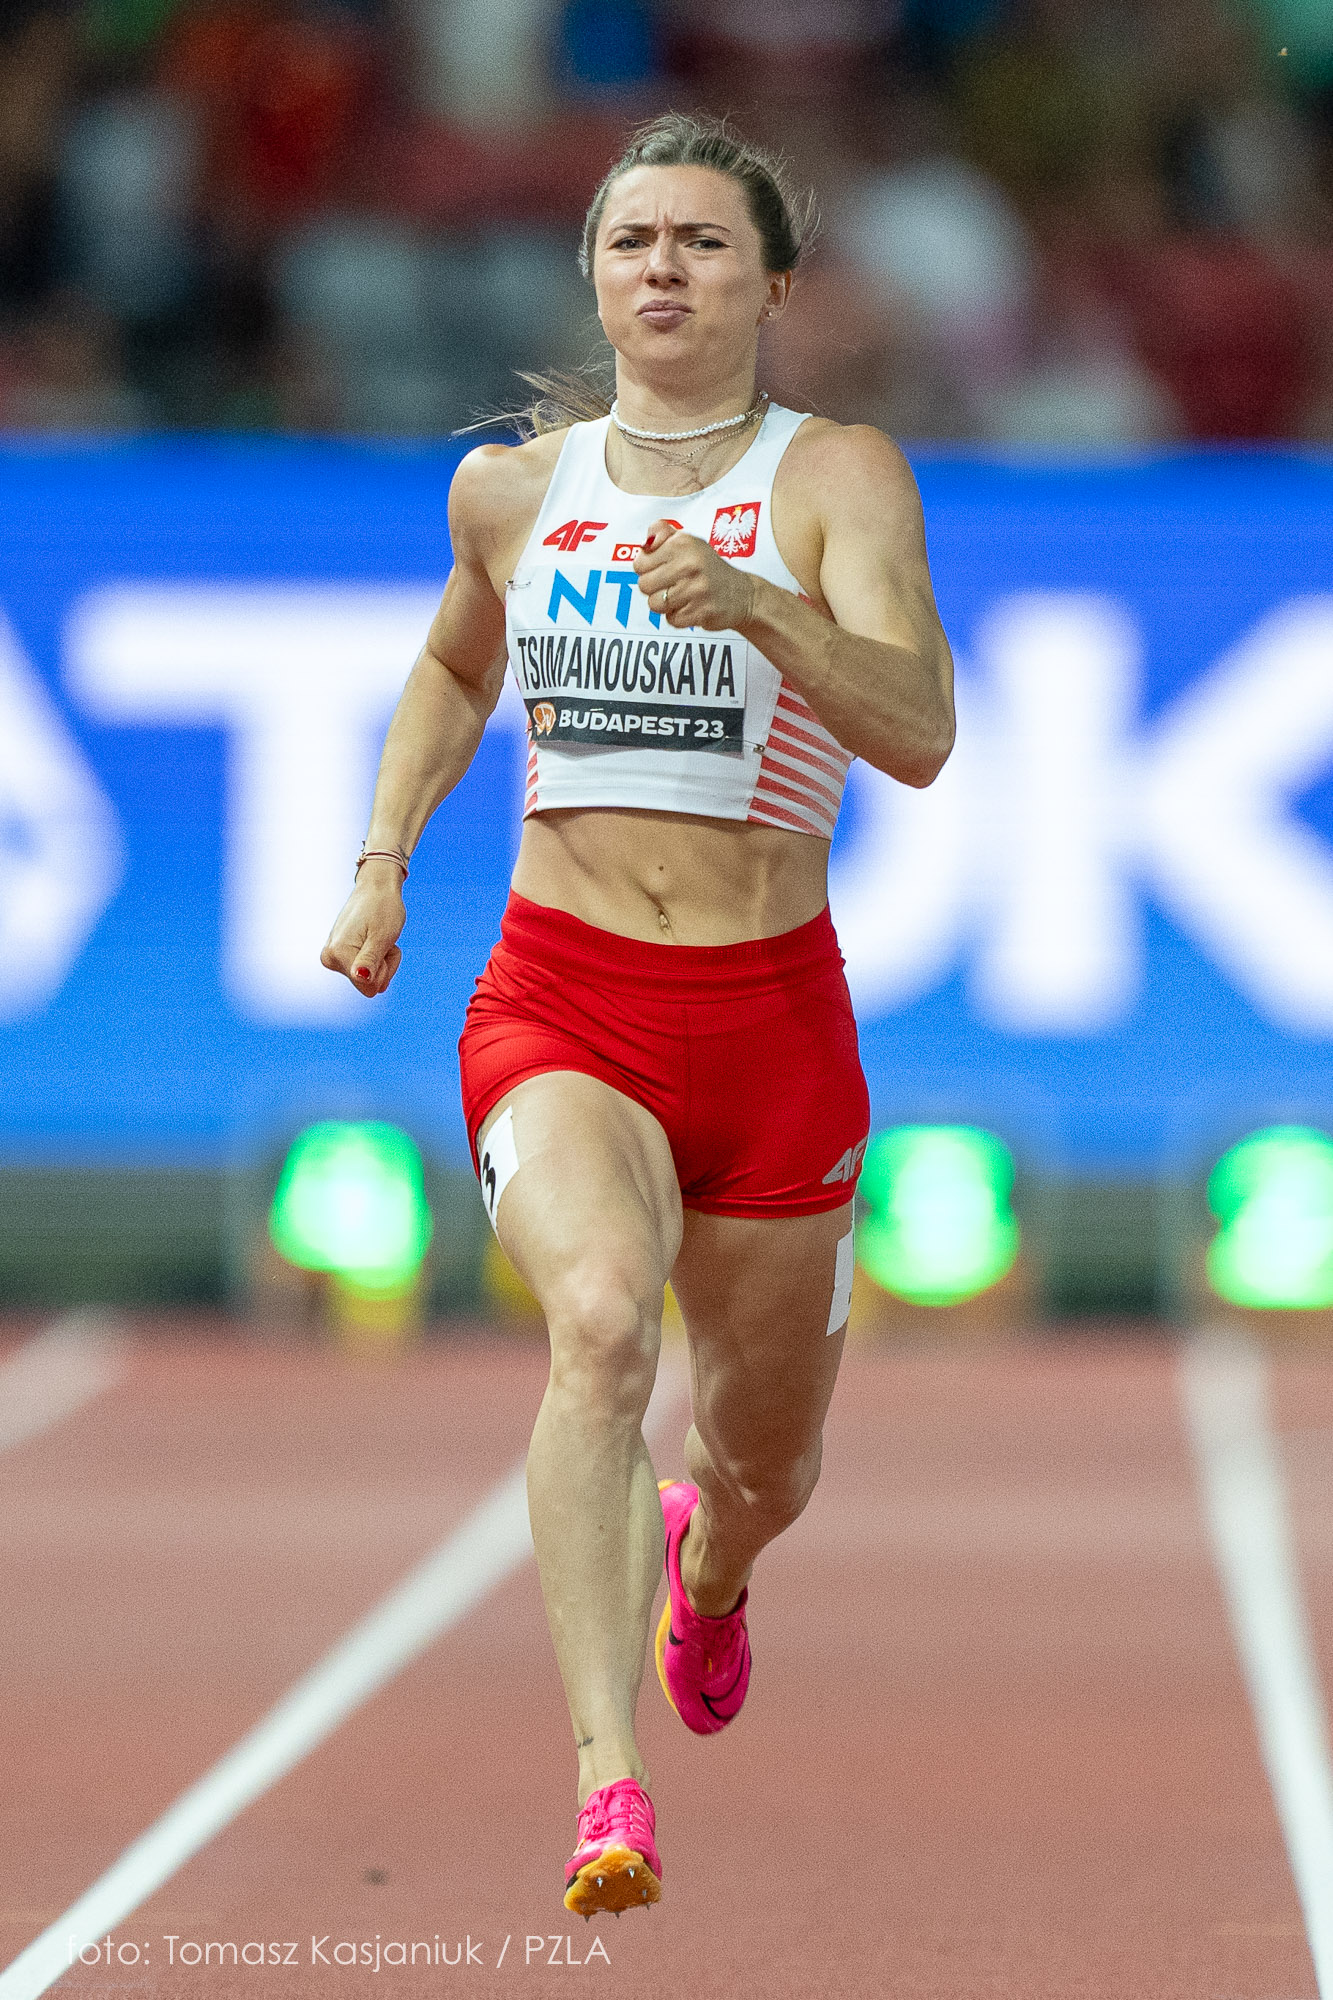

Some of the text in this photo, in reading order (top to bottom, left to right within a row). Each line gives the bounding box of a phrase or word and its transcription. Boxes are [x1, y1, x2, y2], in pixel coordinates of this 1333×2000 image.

[542, 519, 609, 552] 4F
[547, 568, 695, 632] NT
[517, 635, 736, 698] TSIMANOUSKAYA
[558, 708, 725, 739] BUDAPEST 23
